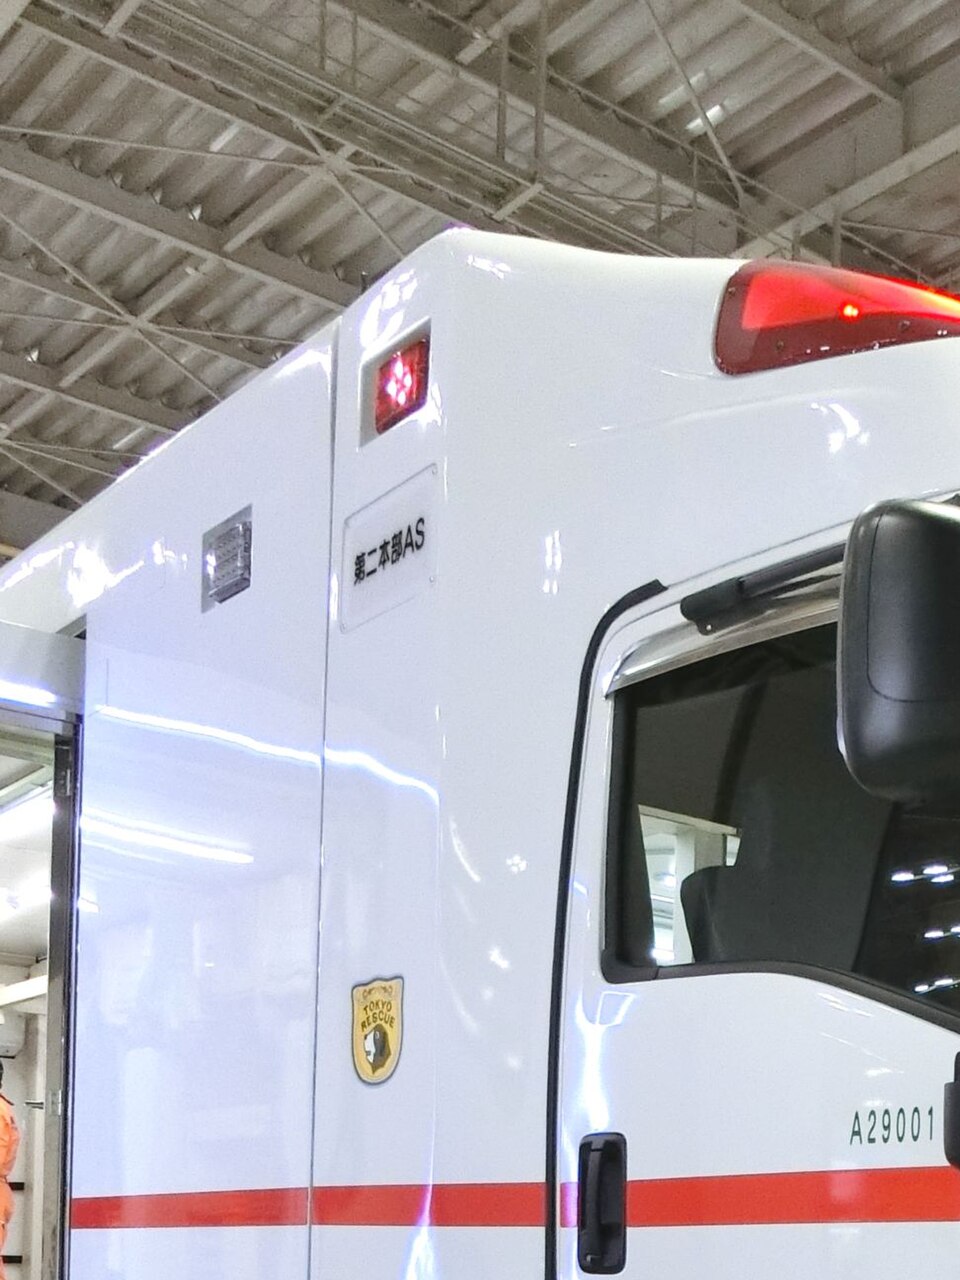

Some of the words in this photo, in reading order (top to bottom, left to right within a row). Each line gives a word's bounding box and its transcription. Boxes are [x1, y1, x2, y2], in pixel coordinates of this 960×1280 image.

[354, 518, 425, 586] 第二本部AS
[360, 1010, 396, 1032] RESCUE
[363, 999, 392, 1016] TOKYO
[849, 1106, 933, 1145] A29001
